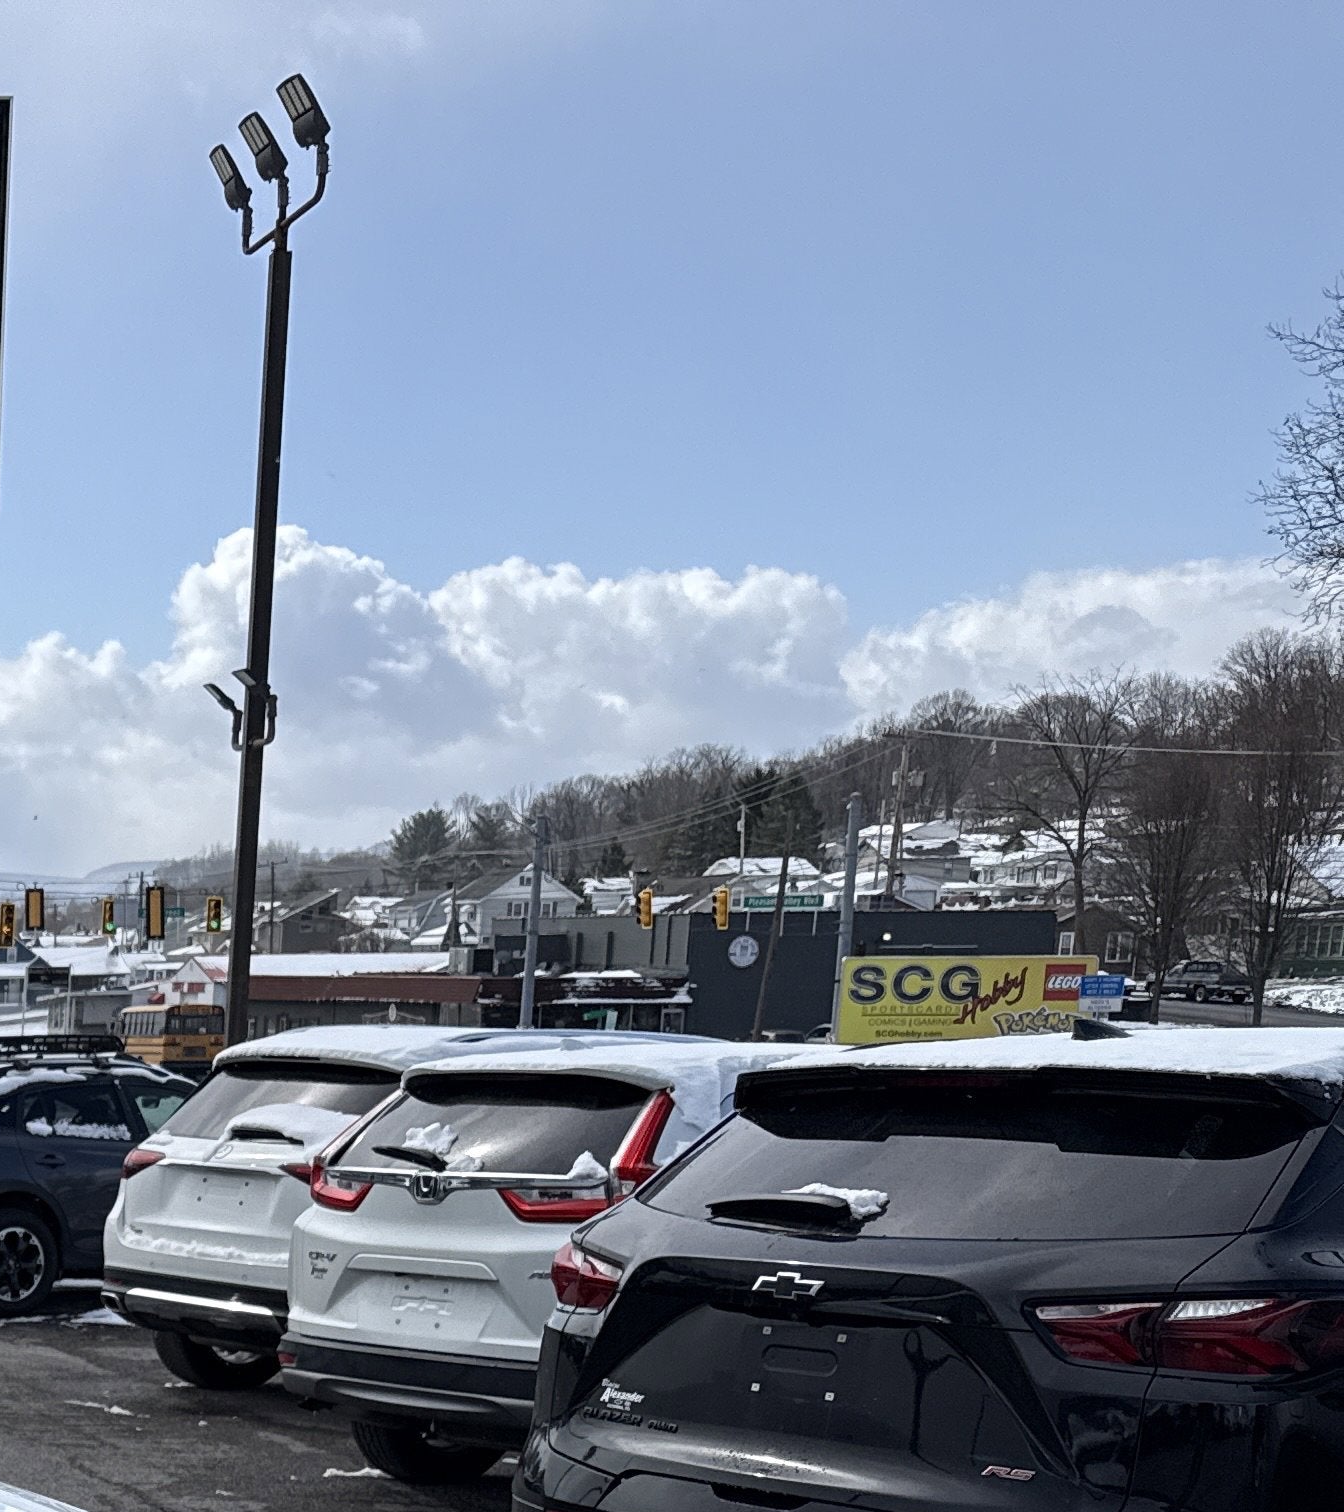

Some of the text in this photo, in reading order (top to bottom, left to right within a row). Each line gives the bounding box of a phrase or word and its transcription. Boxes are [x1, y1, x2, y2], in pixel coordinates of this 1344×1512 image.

[748, 897, 779, 907] Pleasan
[849, 964, 982, 1004] SCG
[1046, 975, 1082, 990] LEGO
[953, 966, 1029, 1025] Hobby
[868, 1017, 953, 1027] COMICS GAMING
[599, 1386, 646, 1404] Alexander
[980, 1465, 1036, 1481] RS
